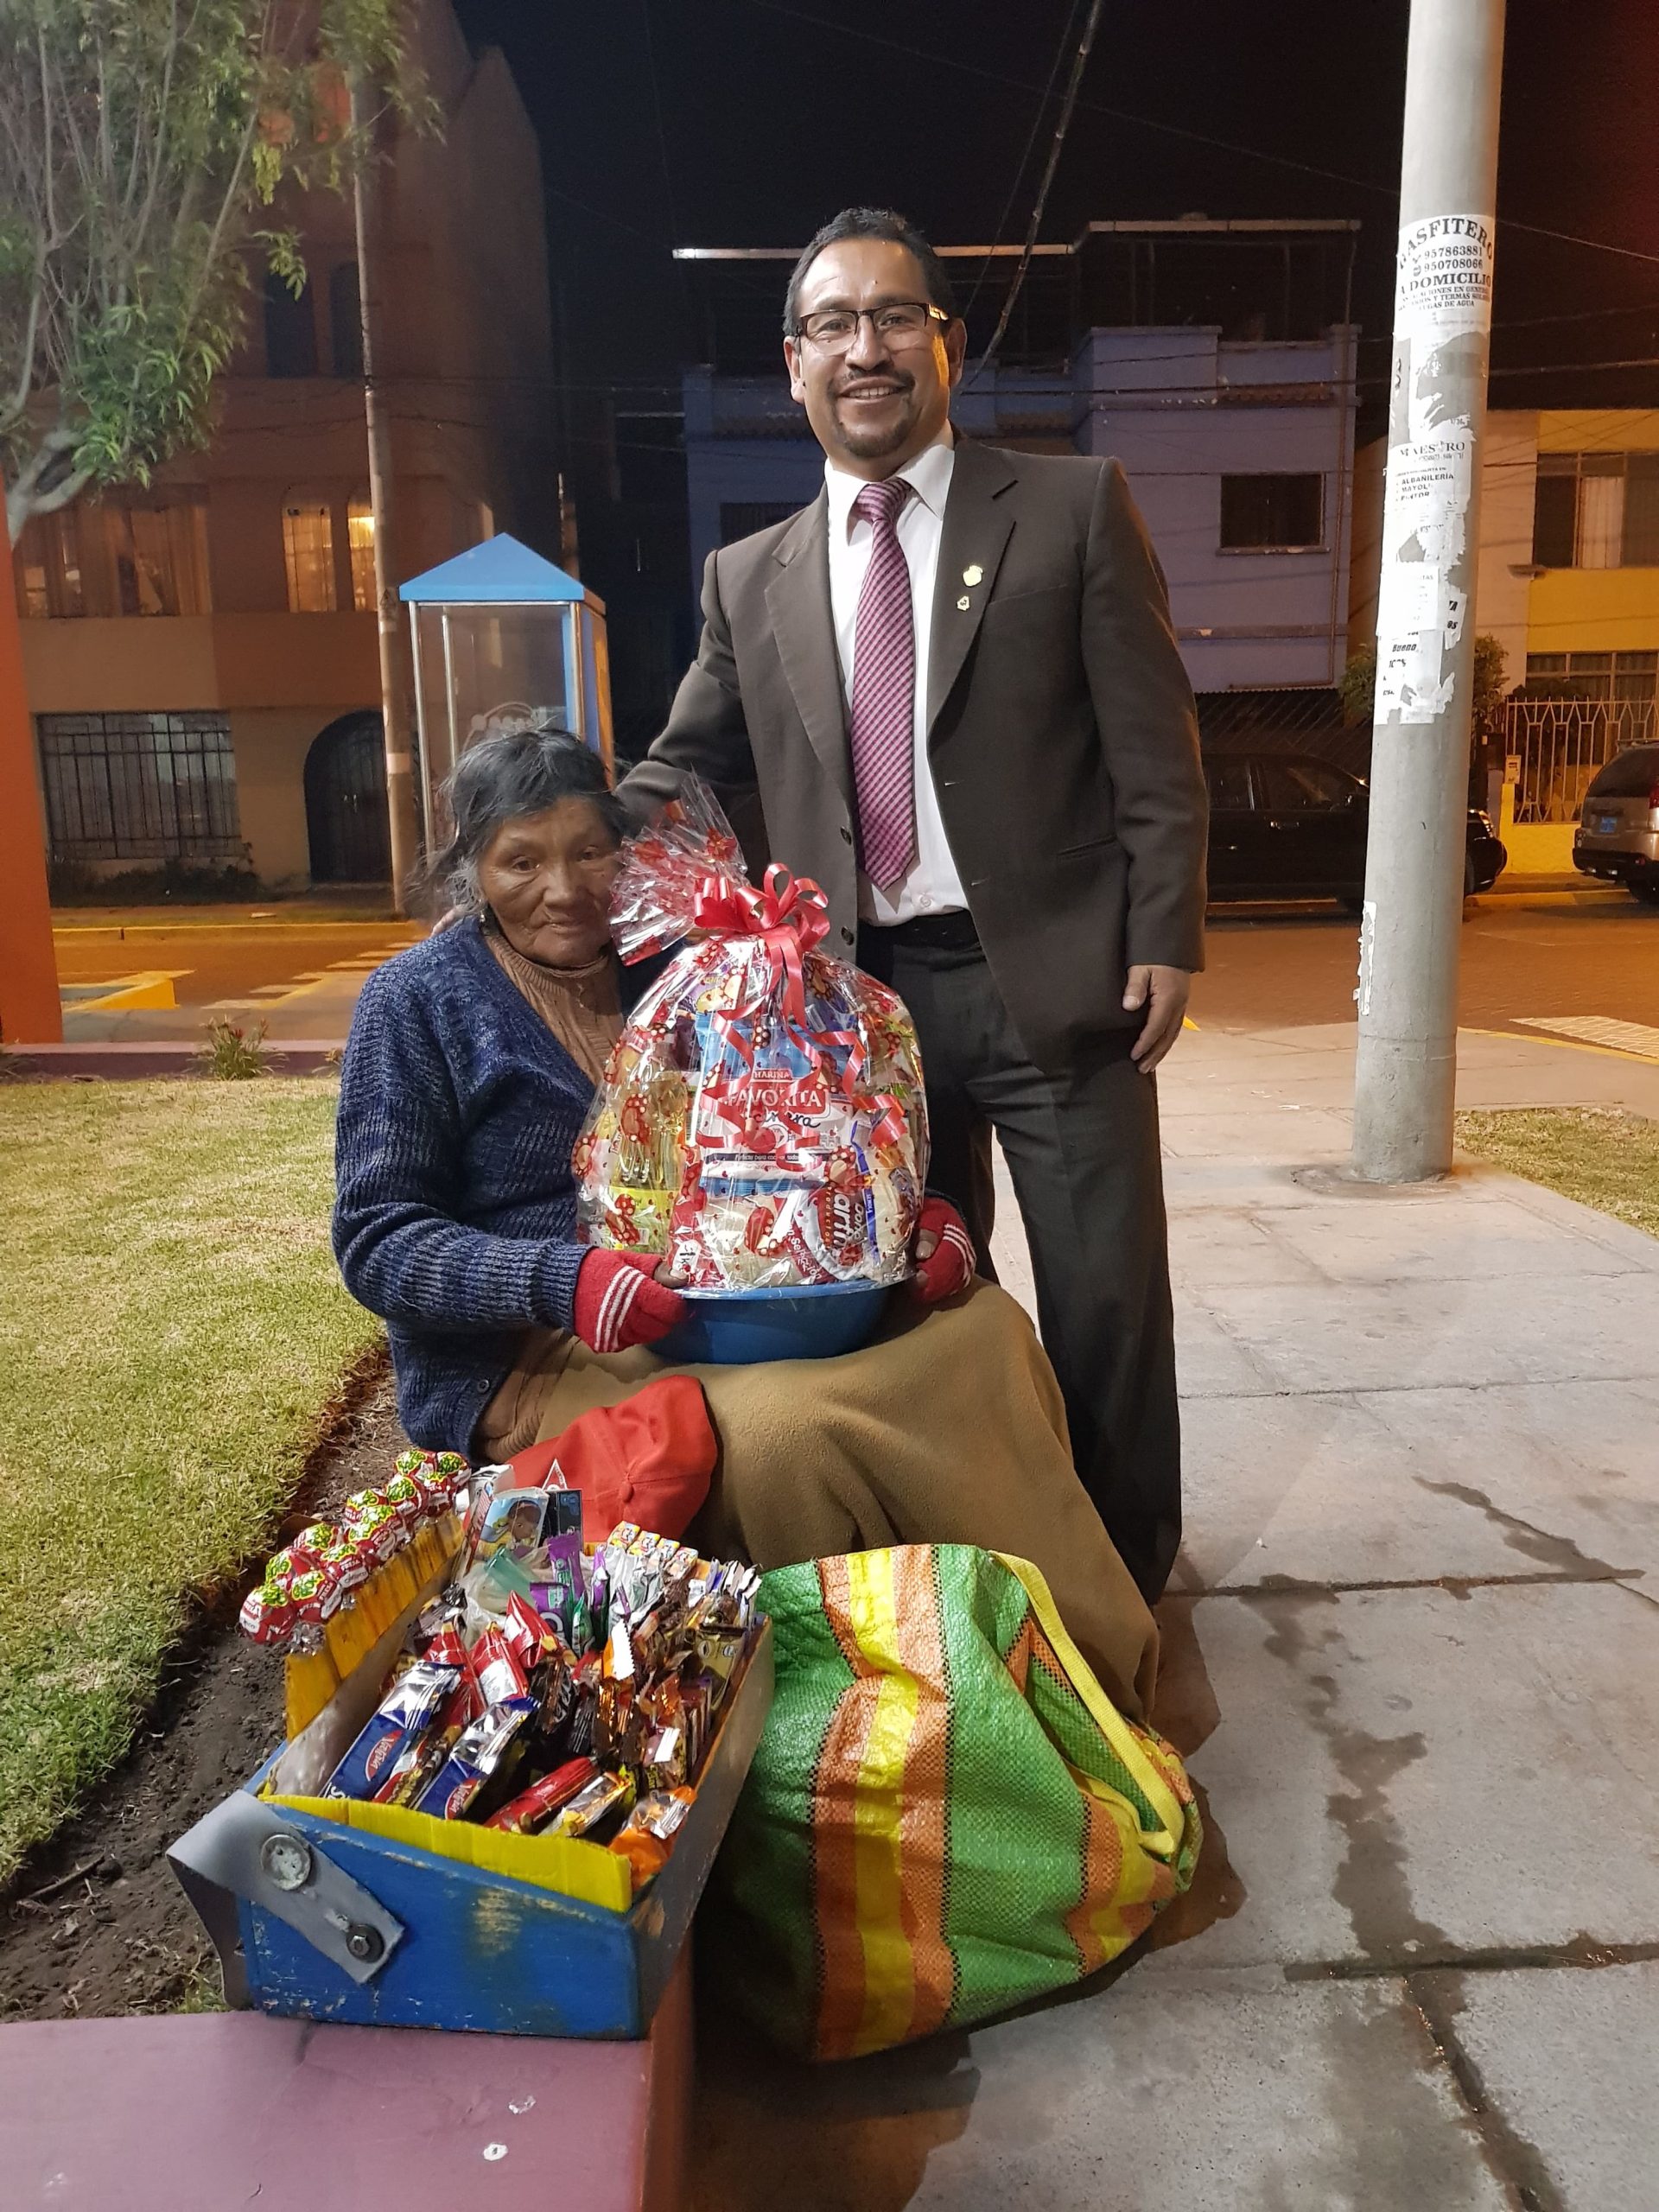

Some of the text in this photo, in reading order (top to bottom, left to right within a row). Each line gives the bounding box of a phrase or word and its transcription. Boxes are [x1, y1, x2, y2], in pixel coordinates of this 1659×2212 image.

[1425, 245, 1483, 259] 957863881
[1424, 258, 1484, 272] 950708066
[1409, 272, 1492, 292] DOMICILIO
[754, 1071, 790, 1079] HARINA
